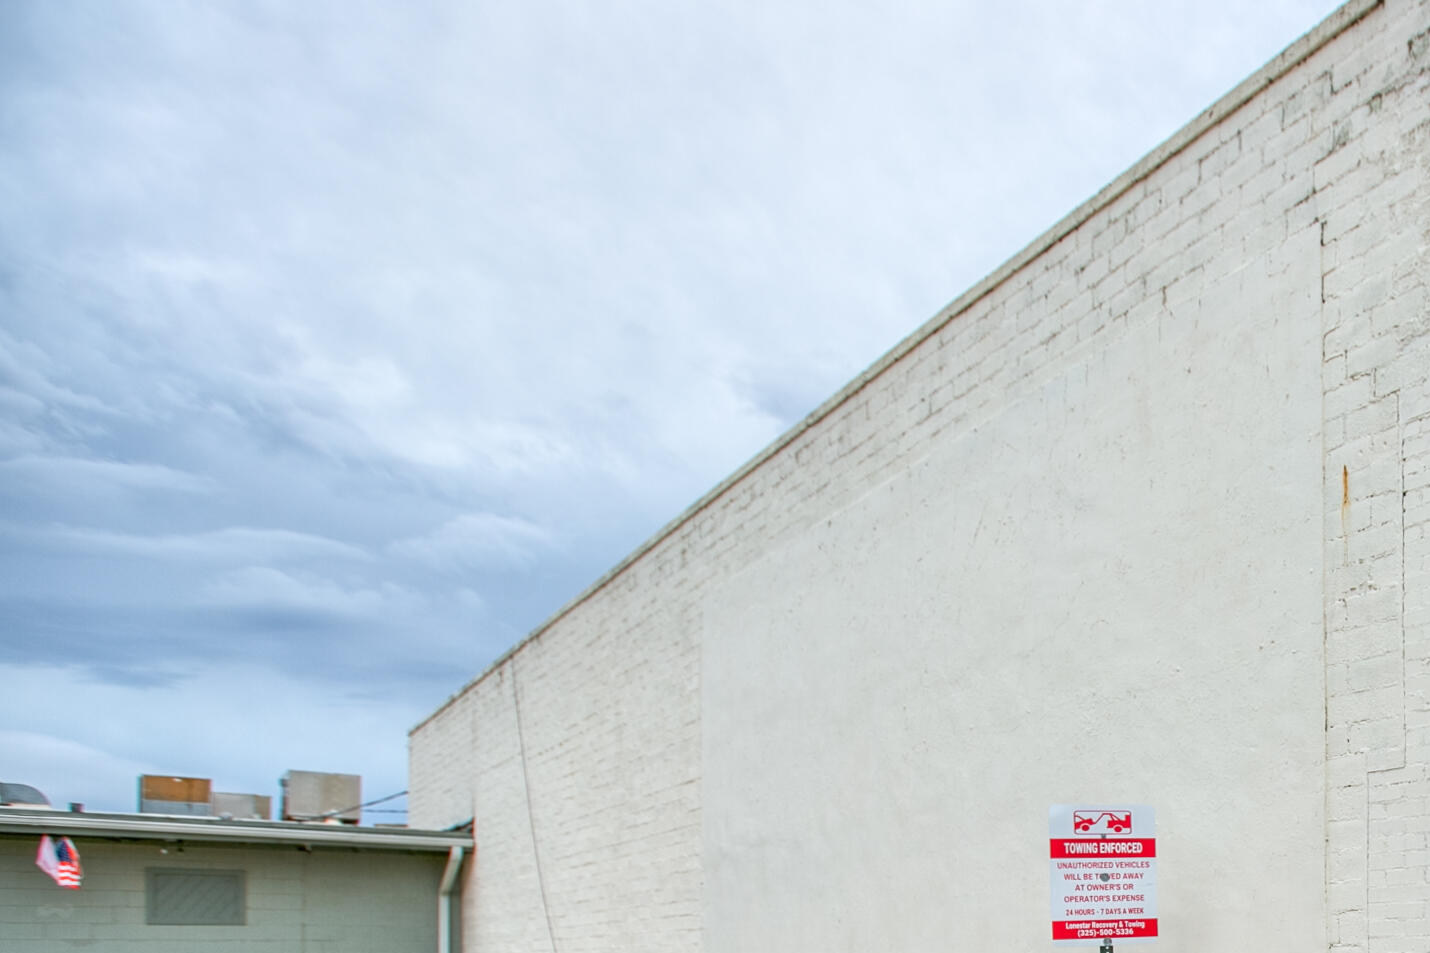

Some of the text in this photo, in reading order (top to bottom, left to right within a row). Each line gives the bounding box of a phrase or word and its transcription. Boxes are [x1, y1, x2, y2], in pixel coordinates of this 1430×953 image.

[1063, 842, 1143, 854] TOWING ENFORCED
[1095, 872, 1121, 880] TED
[1122, 872, 1144, 880] AWAY
[1064, 894, 1144, 903] OPERATOR'S EXPENSE
[1074, 908, 1095, 916] HOURS
[1065, 922, 1091, 930] Lonestar
[1092, 921, 1118, 930] Recovery
[1124, 920, 1145, 928] Towing
